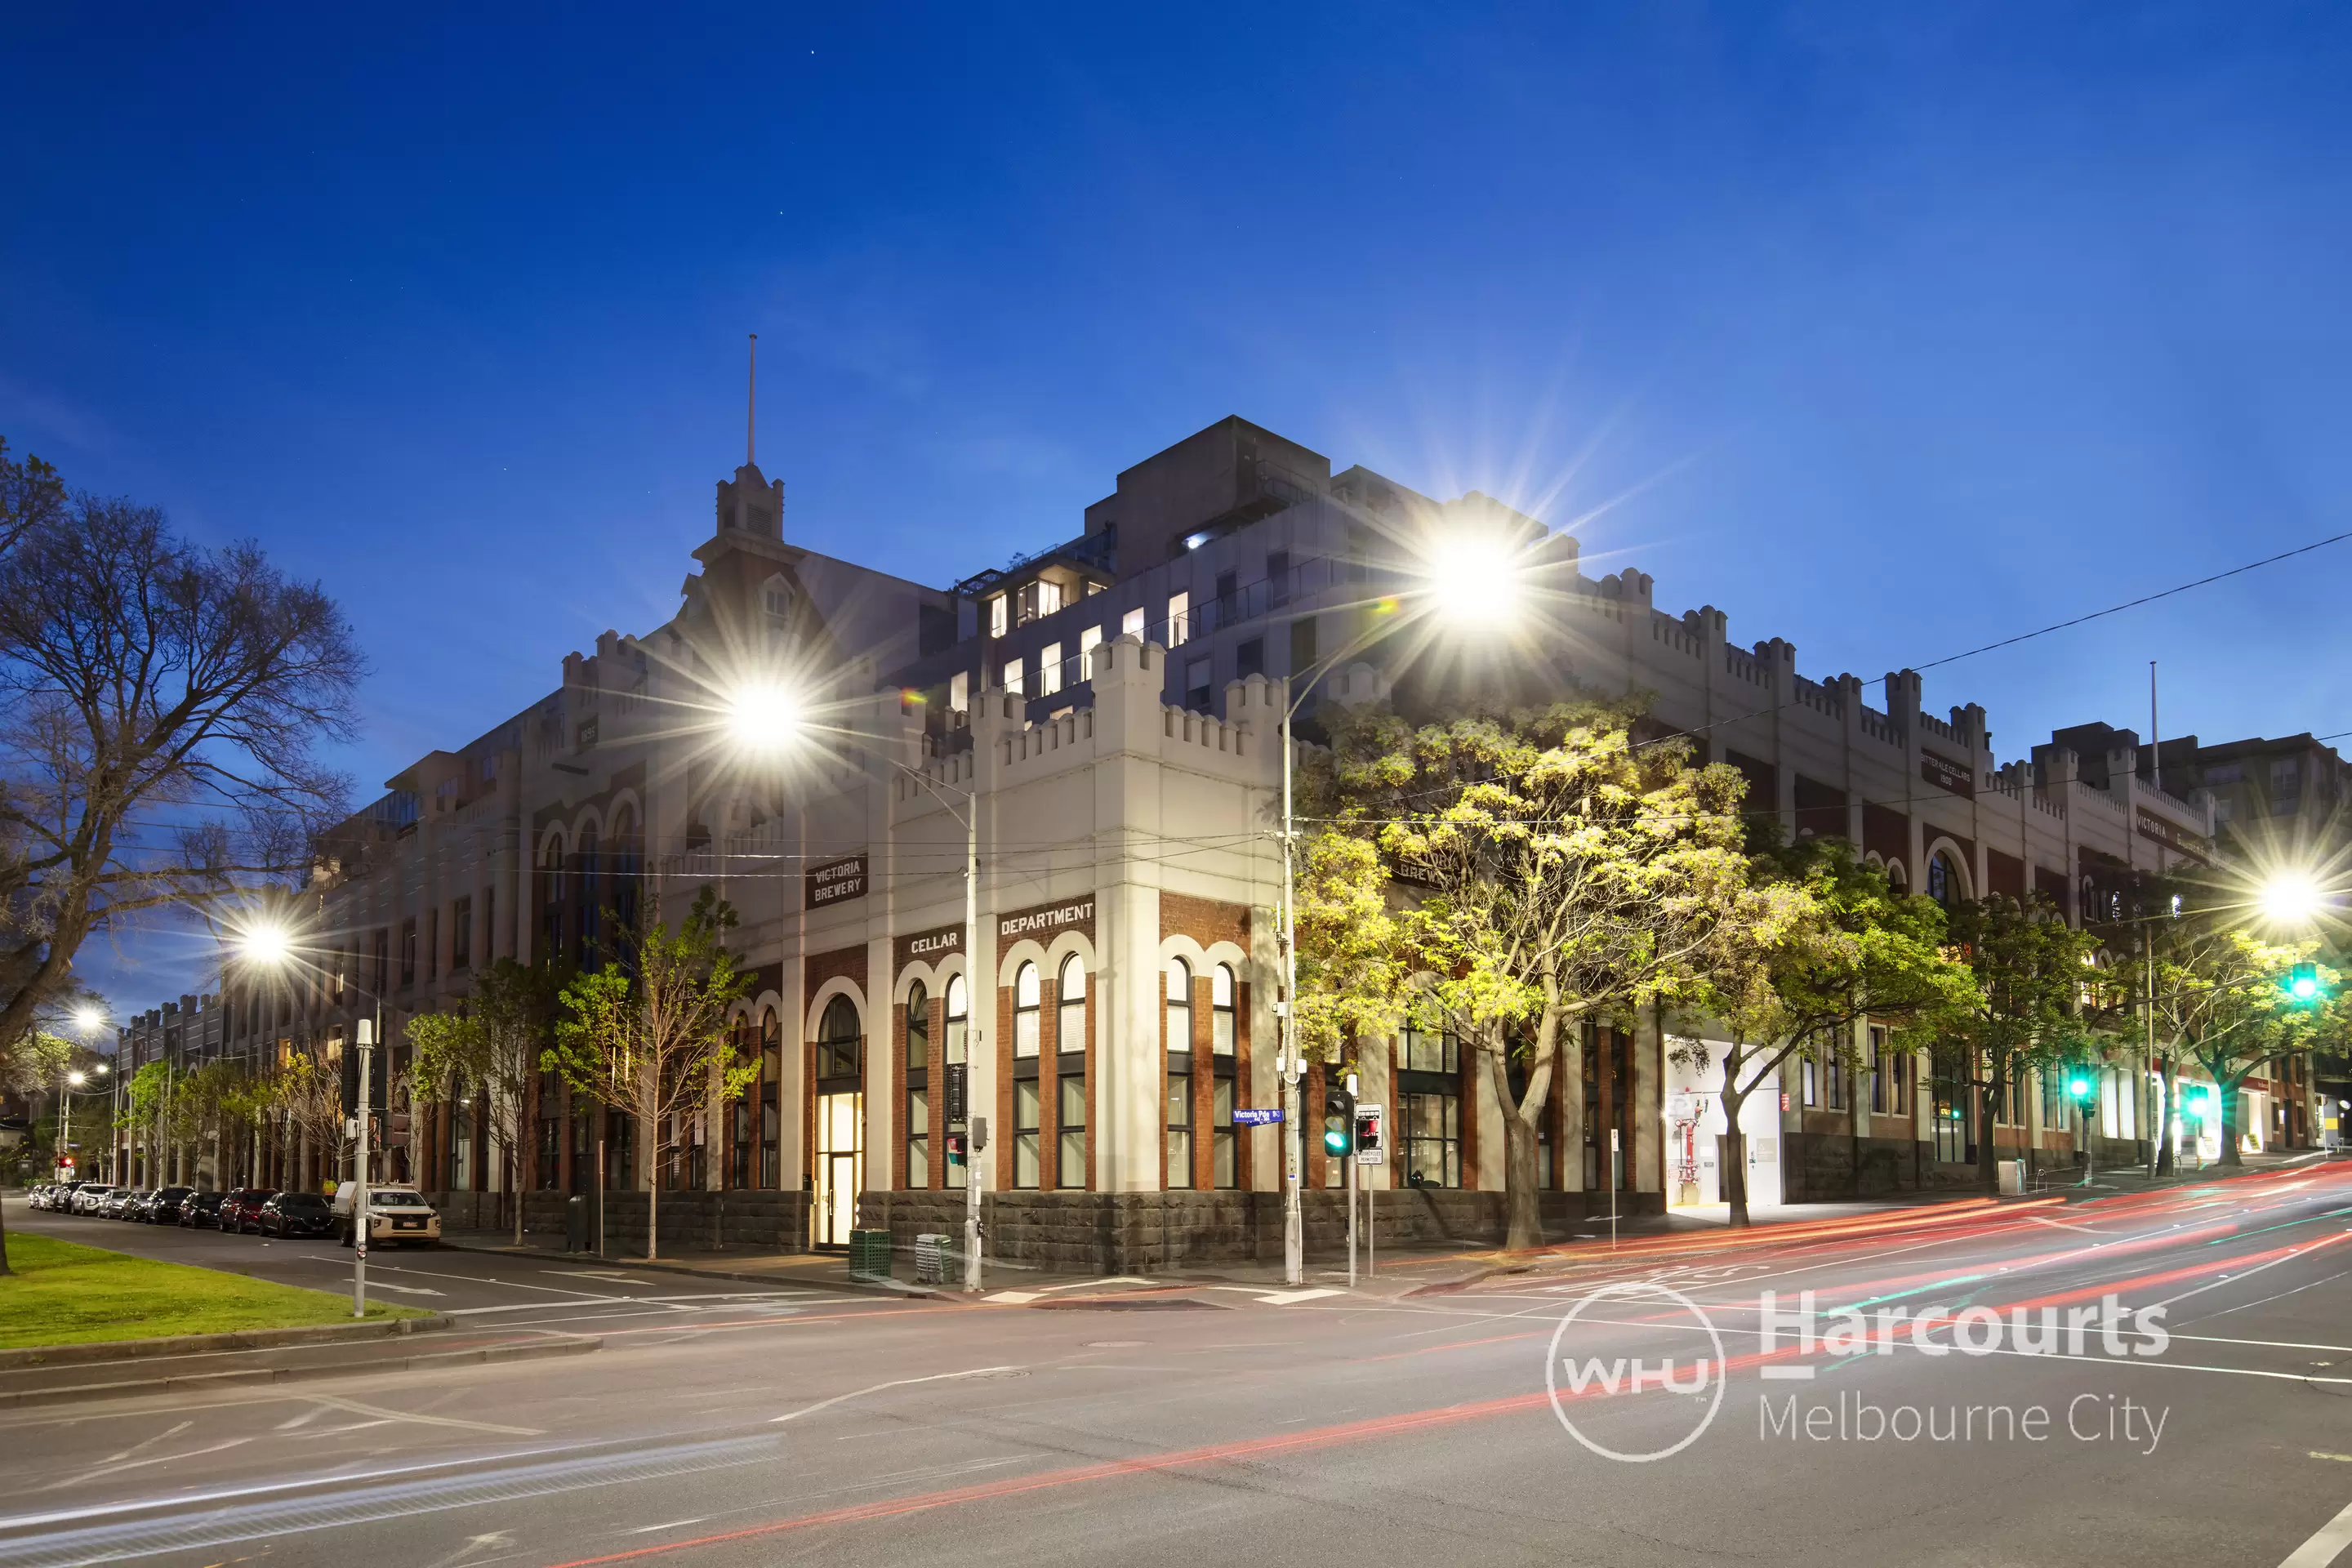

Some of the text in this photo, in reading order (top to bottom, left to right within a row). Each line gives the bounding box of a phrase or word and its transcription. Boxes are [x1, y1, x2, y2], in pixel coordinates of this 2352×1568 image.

[1920, 753, 1971, 782] BITTER ALE CELLARS
[2136, 813, 2167, 839] VICTORIA
[816, 860, 861, 884] VICTORIA
[815, 877, 862, 902] BREWERY
[1001, 902, 1094, 936] DEPARTMENT
[911, 932, 958, 954] CELLAR
[1234, 1110, 1271, 1119] Victoria Pde
